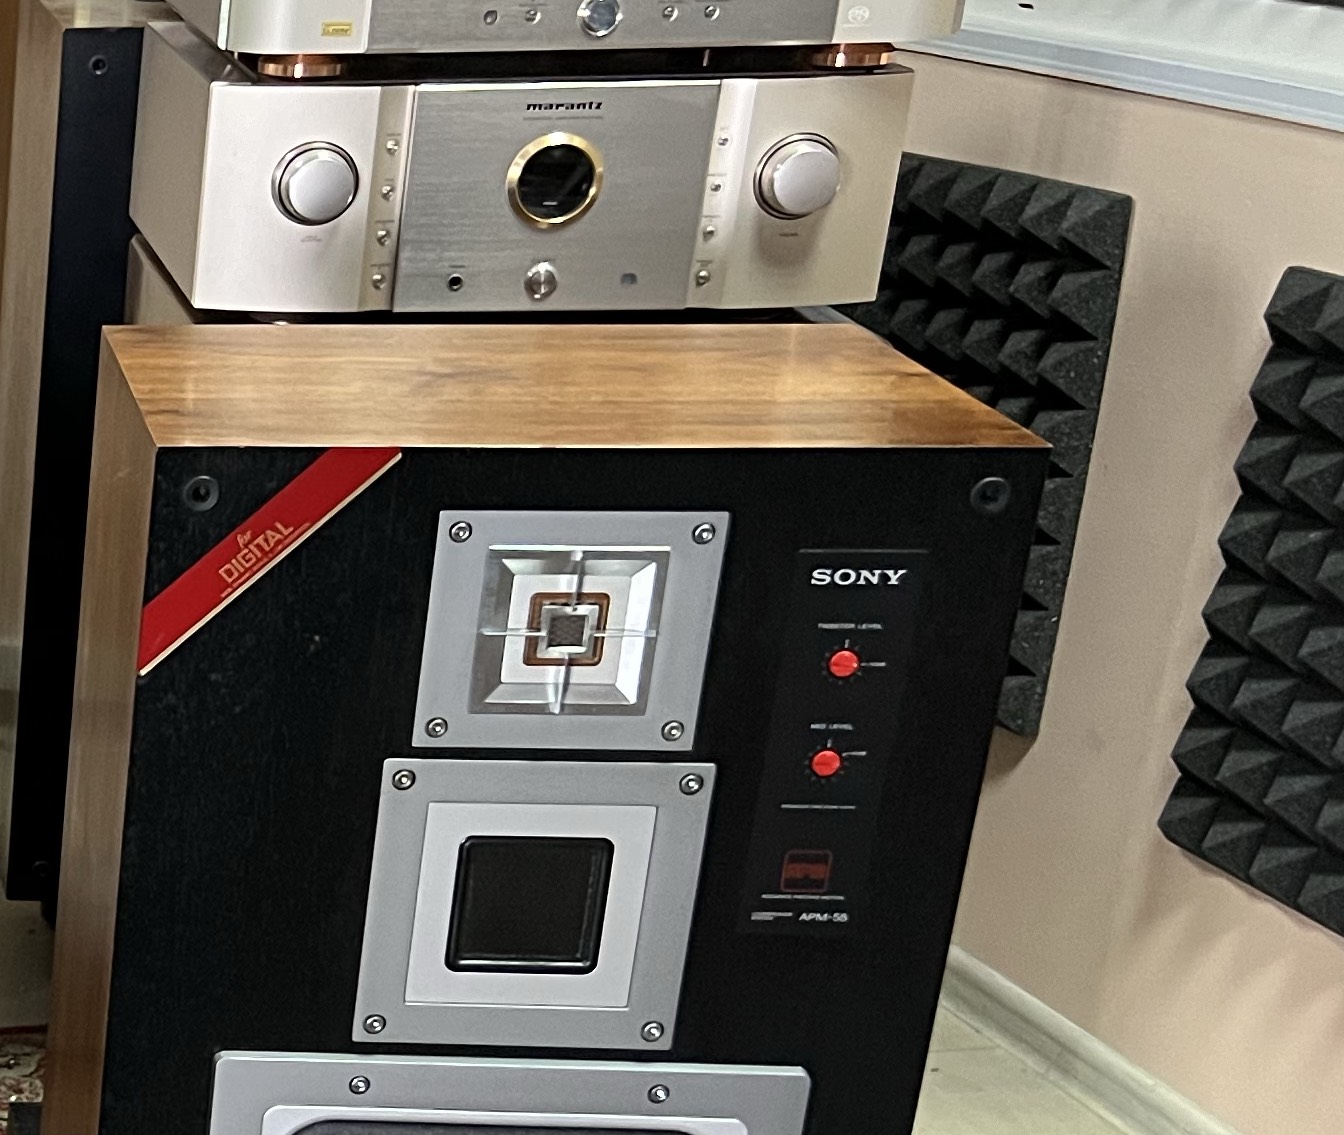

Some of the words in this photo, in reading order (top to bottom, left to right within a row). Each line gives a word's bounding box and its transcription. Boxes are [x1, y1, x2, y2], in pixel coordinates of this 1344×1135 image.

[526, 101, 603, 111] marantz
[218, 522, 294, 583] DIGITAL
[810, 568, 908, 586] SONY
